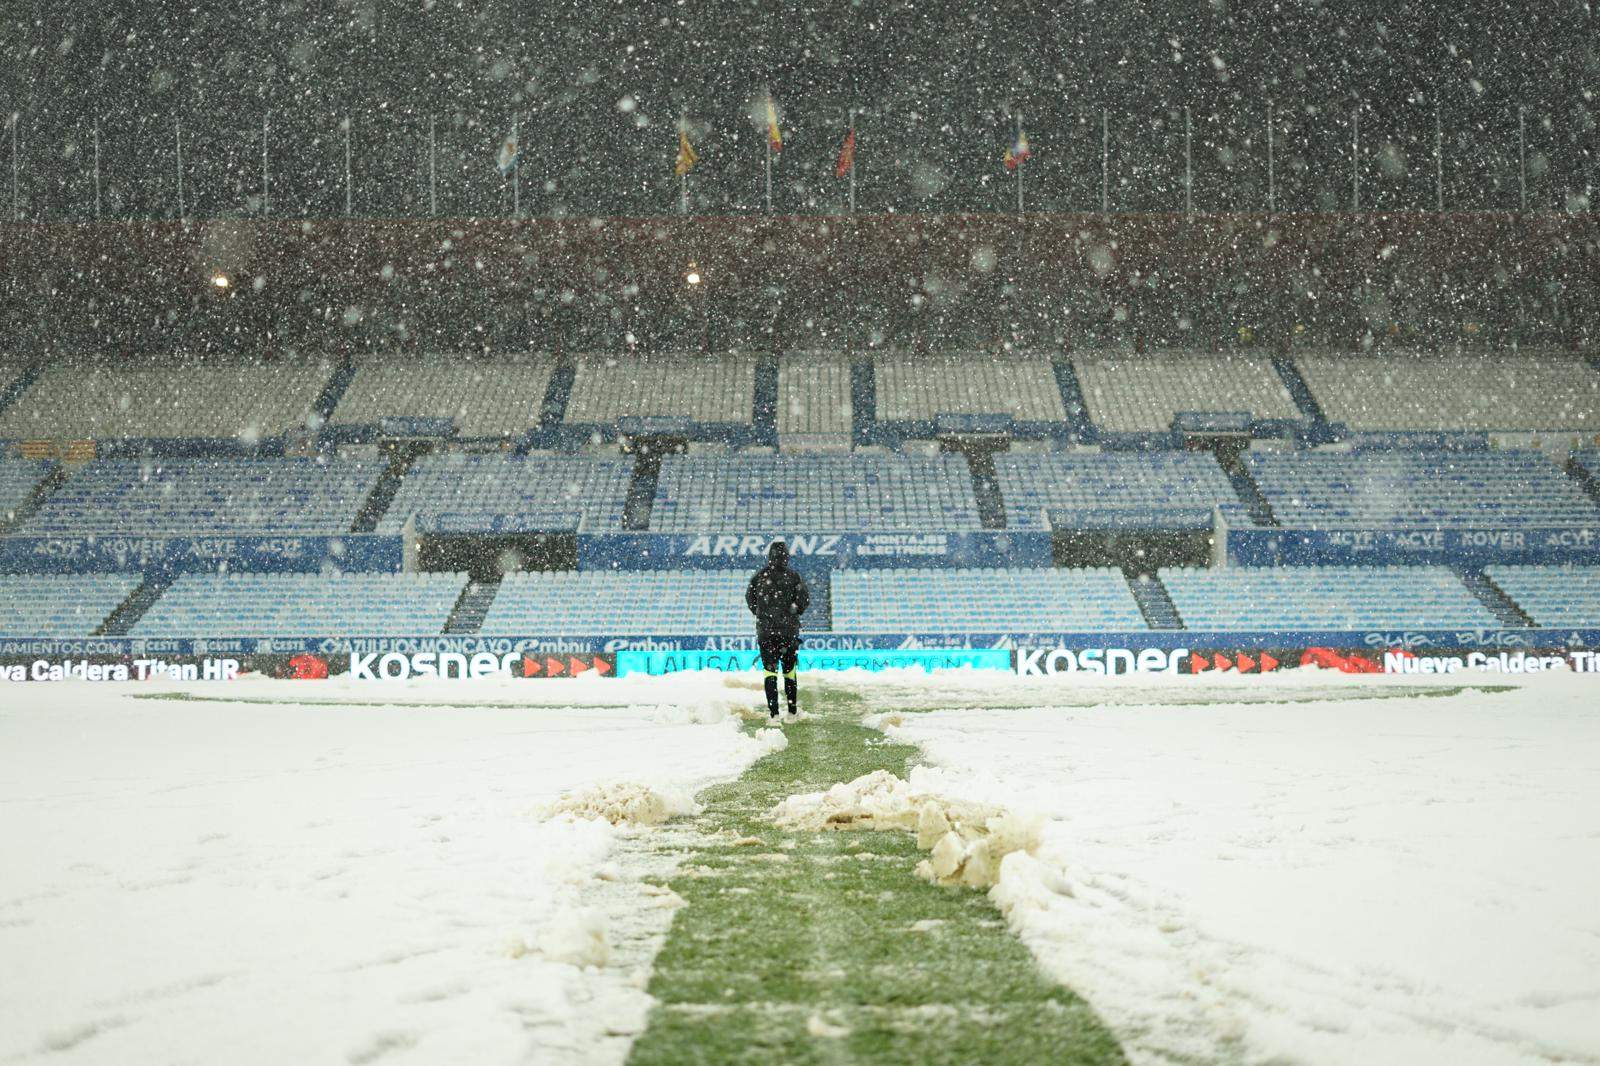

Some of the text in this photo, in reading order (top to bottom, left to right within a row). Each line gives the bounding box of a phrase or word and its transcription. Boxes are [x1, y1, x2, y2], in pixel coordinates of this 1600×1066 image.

[684, 535, 843, 556] ARRANZ
[420, 638, 513, 653] MONCAYO
[31, 660, 128, 680] Caldera
[133, 659, 198, 680] Titan
[203, 659, 240, 680] HR
[1384, 651, 1463, 673] Nueva
[1467, 651, 1565, 674] Caldera
